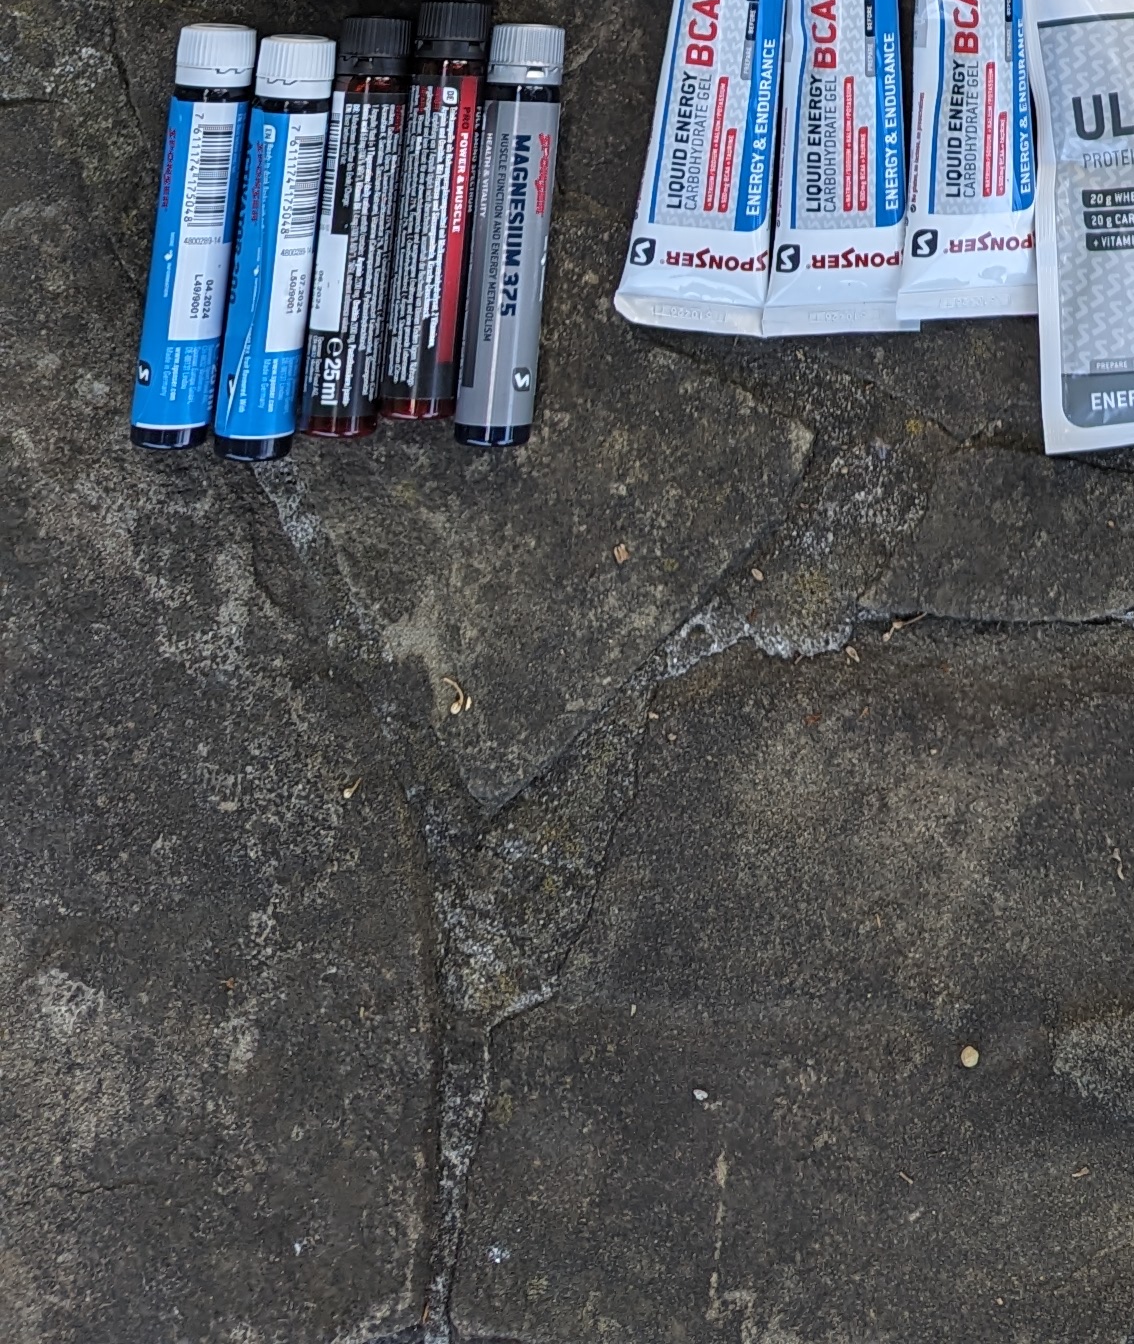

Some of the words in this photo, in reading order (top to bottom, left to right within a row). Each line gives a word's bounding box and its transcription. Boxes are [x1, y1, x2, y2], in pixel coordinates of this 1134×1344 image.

[755, 39, 775, 133] ENDURANCE
[825, 76, 837, 101] GEL
[884, 32, 896, 128] ENDURANCE
[967, 61, 979, 87] GEL
[675, 71, 697, 143] ENERGY
[807, 74, 822, 146] ENERGY
[950, 59, 966, 132] ENERGY
[462, 107, 471, 129] PRO
[885, 131, 897, 143] &
[1019, 116, 1027, 128] &
[457, 133, 469, 174] POWER
[484, 133, 493, 168] HEALTH
[498, 133, 509, 167] MUSCLE
[684, 105, 708, 210] CARBOHYDRATE
[697, 74, 711, 100] GEL
[753, 137, 766, 149] &
[824, 106, 836, 212] CARBOHYDRATE
[963, 92, 978, 198] CARBOHYDRATE
[1020, 131, 1031, 194] ENERGY
[457, 175, 465, 184] &
[667, 149, 687, 209] LIQUID
[746, 154, 764, 216] ENERGY
[806, 152, 821, 212] LIQUID
[885, 148, 898, 210] ENERGY
[946, 137, 963, 198] LIQUID
[452, 185, 464, 233] MUSCLE
[479, 177, 490, 219] VITALITY
[495, 169, 507, 218] FUNCTION
[505, 134, 531, 267] MAGNESIUM
[1090, 194, 1103, 205] 20
[1105, 196, 1112, 206] g
[492, 220, 502, 240] AND
[1091, 215, 1104, 226] 20
[1106, 217, 1112, 227] g
[489, 242, 499, 282] ENERGY
[666, 248, 768, 272] SPONSER
[812, 248, 903, 269] PONSER
[949, 231, 1035, 254] PONSER
[202, 279, 213, 319] 04.2024
[297, 274, 306, 313] 07.2024
[483, 282, 497, 342] METABOLISM
[500, 272, 519, 317] 375
[1096, 361, 1128, 370] PREPARE
